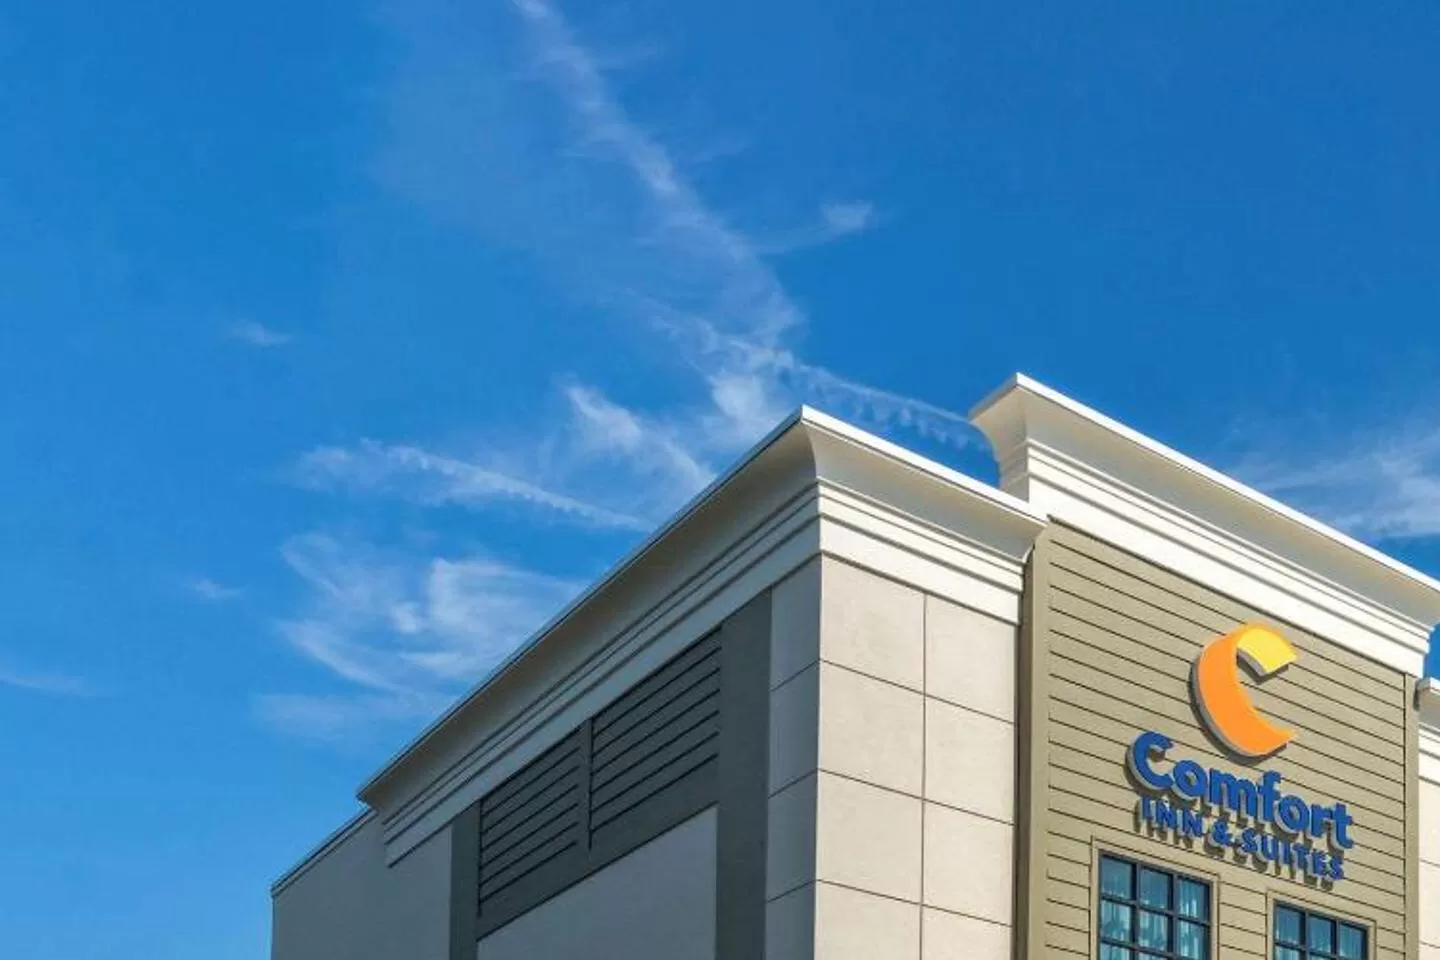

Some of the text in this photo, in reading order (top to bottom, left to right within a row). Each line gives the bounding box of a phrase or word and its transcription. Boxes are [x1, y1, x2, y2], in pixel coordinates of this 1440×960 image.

[1130, 730, 1354, 850] Comfort
[1138, 794, 1345, 881] INN & SUITES
